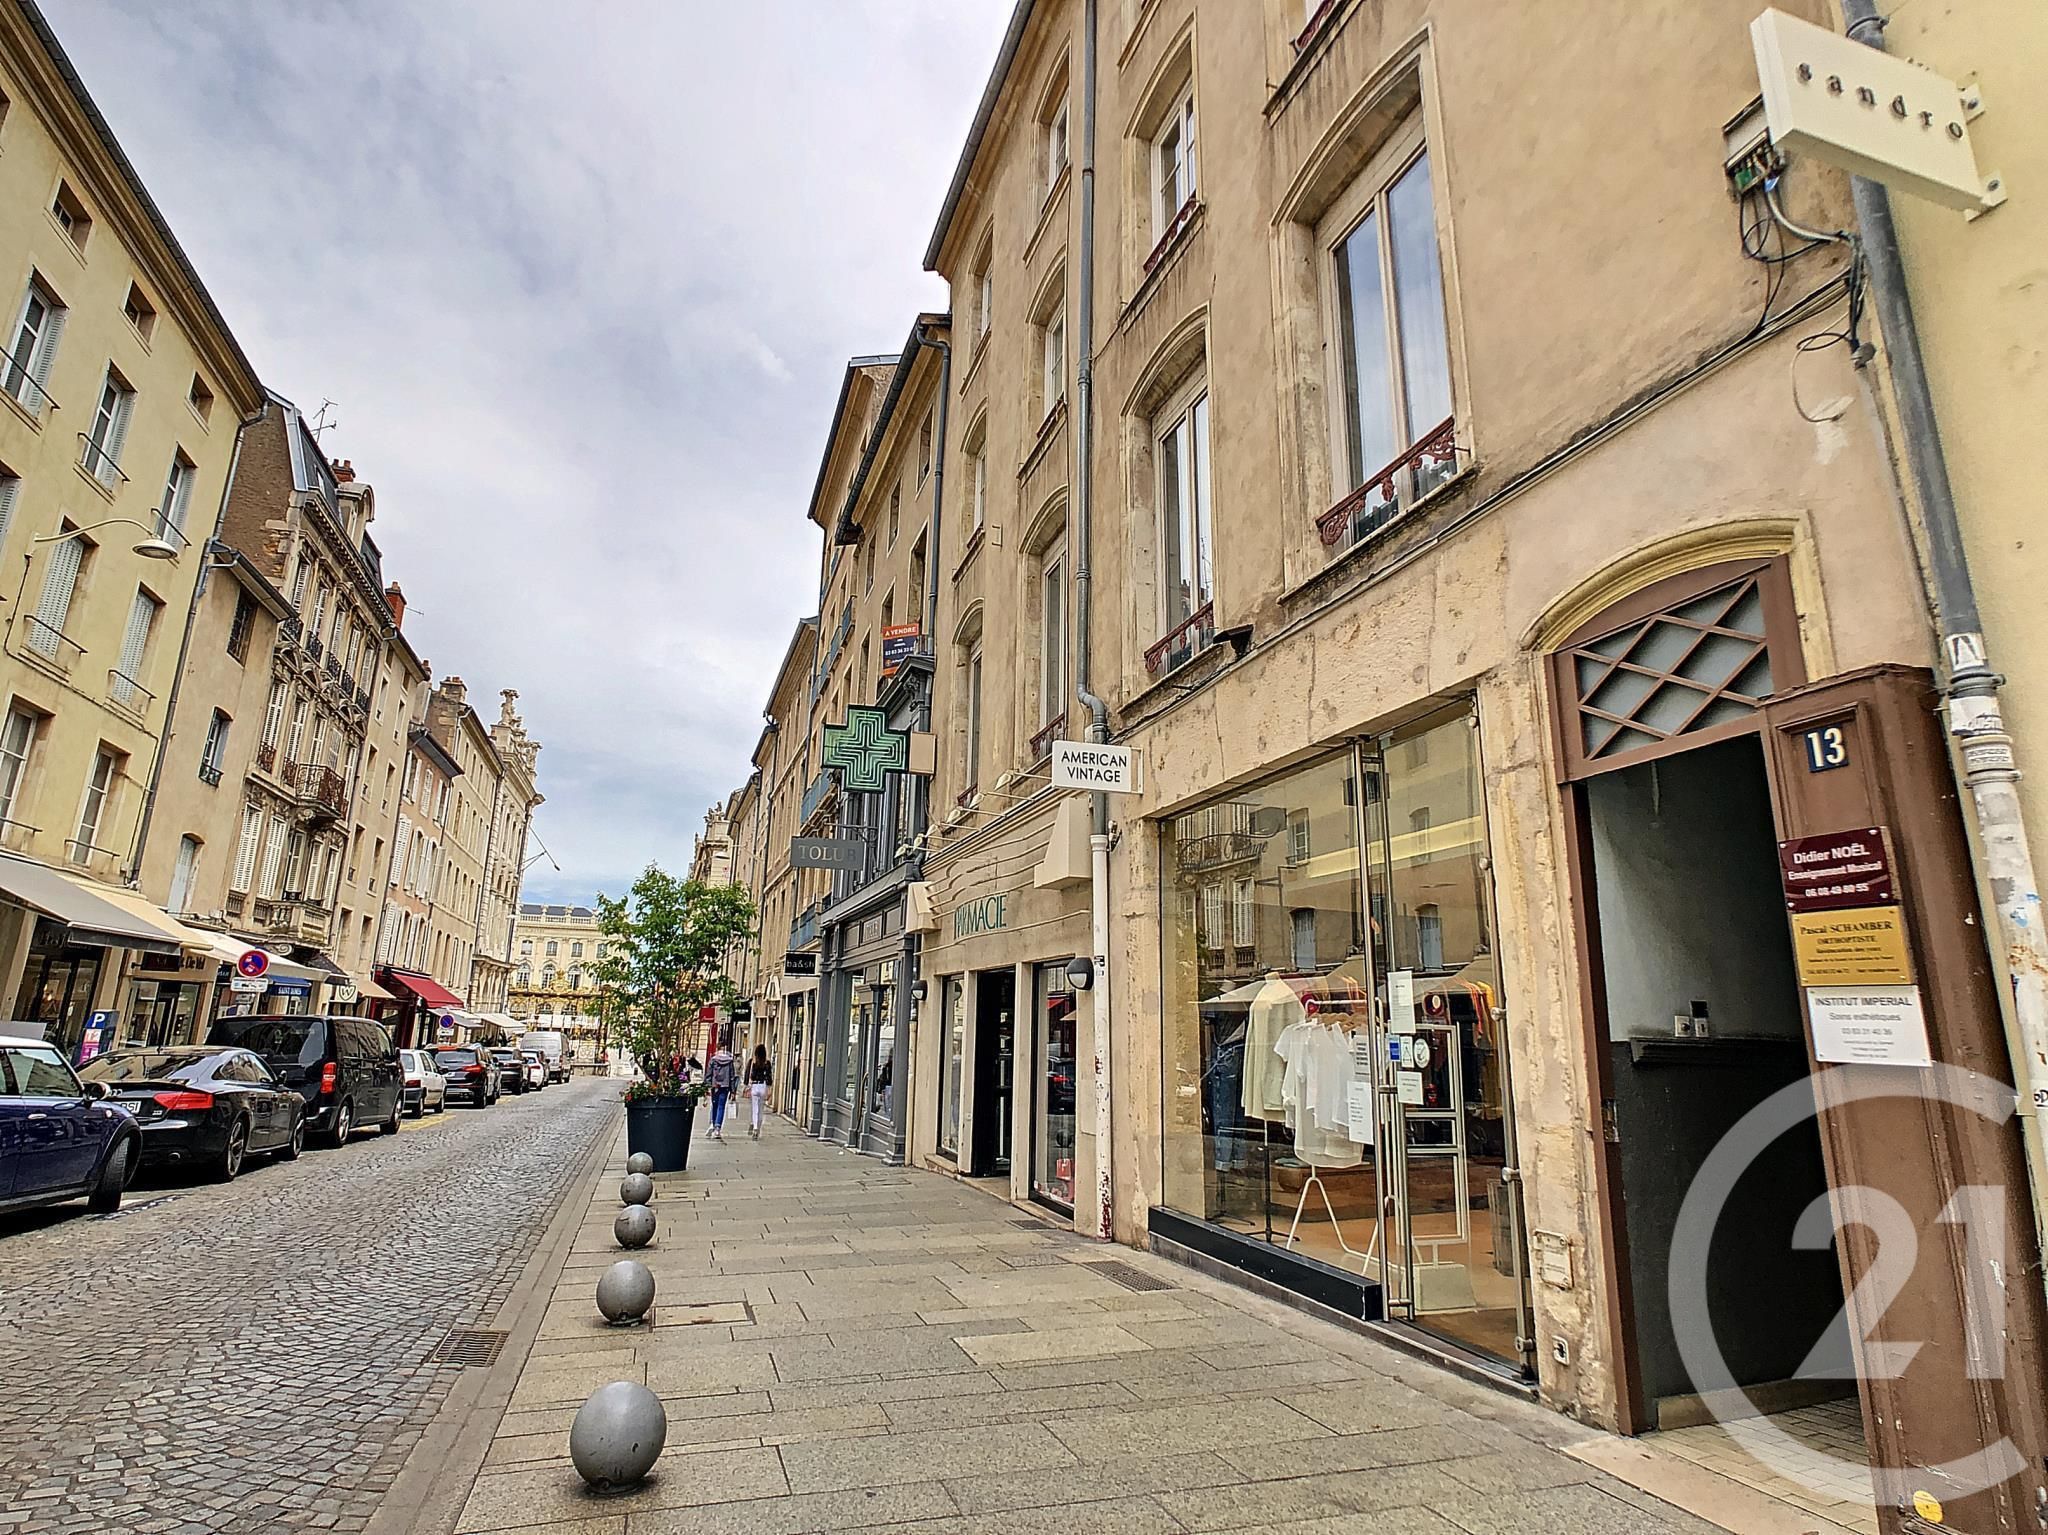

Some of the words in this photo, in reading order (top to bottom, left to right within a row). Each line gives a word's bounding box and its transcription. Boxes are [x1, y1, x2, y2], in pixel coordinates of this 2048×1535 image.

[1797, 62, 1964, 140] sandro
[890, 627, 917, 635] VENDRE
[1807, 727, 1845, 767] 13
[1061, 750, 1127, 768] AMERICAN
[1067, 766, 1121, 783] VINTAGE
[1793, 850, 1830, 864] Didier
[1831, 843, 1871, 859] NOËL
[1800, 925, 1827, 935] Pascal
[1830, 920, 1893, 933] SCHAMBER
[1815, 997, 1858, 1006] INSTITUT
[1861, 997, 1913, 1006] IMPERIAL
[1829, 1012, 1852, 1021] Soins
